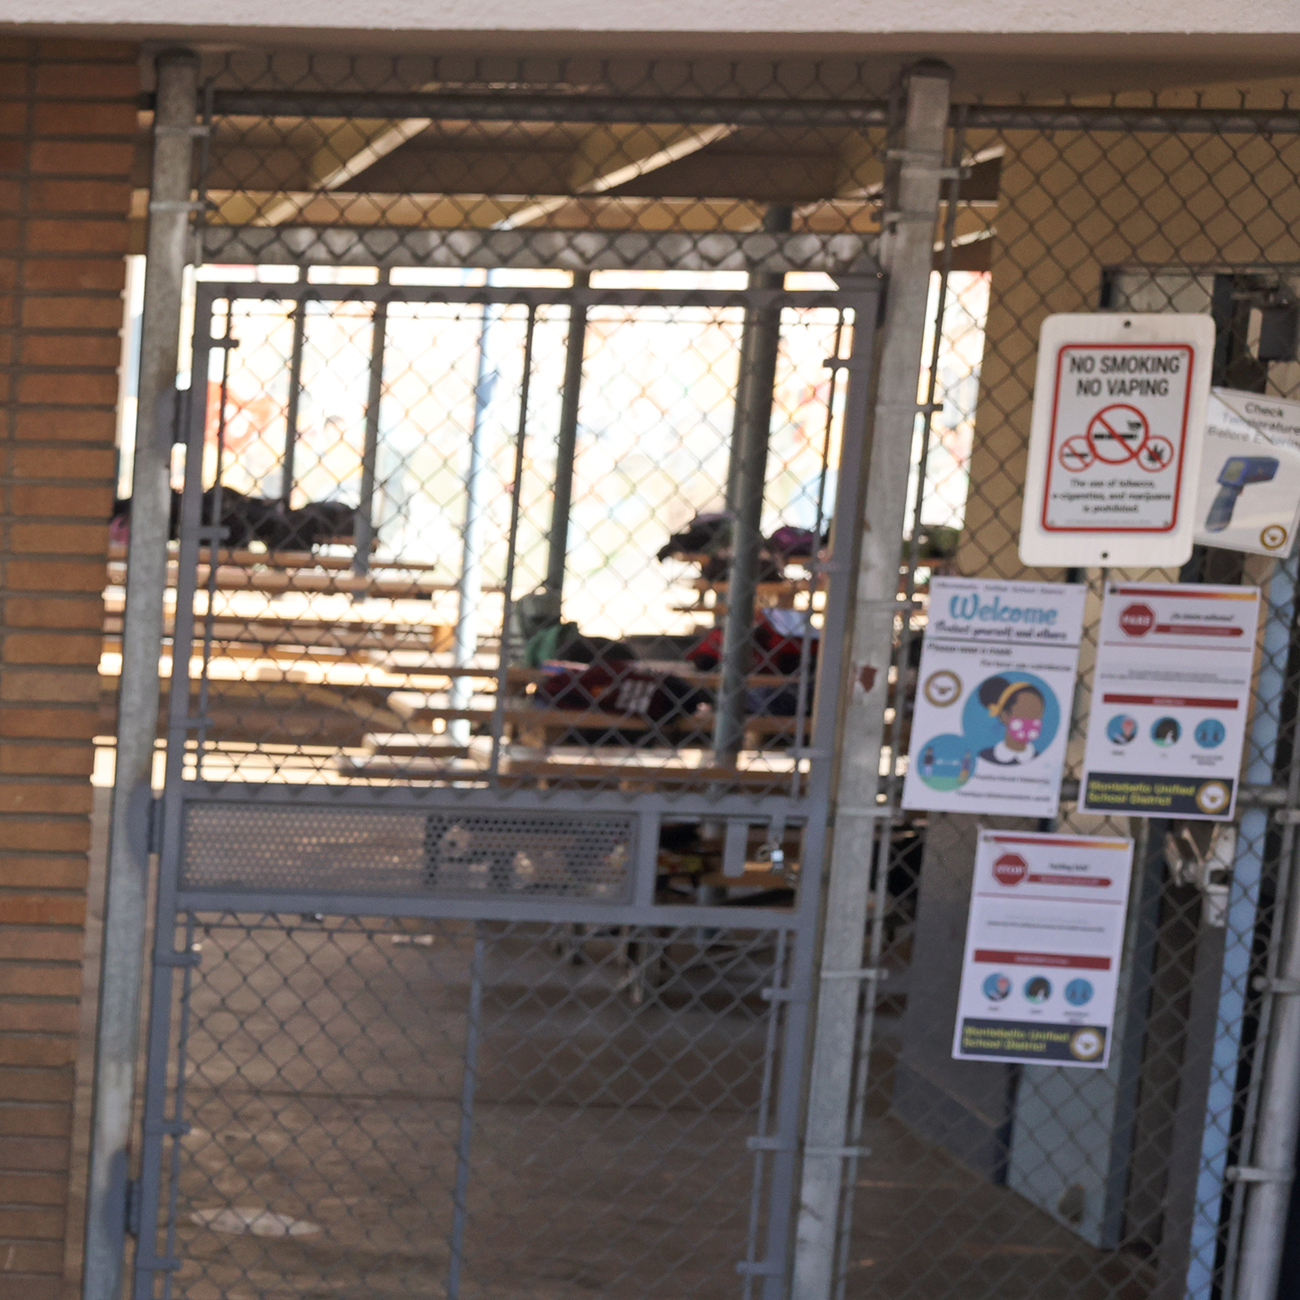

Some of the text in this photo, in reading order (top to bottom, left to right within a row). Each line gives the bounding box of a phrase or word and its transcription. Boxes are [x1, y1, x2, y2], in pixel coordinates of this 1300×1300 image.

[1070, 355, 1180, 375] NO SMOKING
[1076, 378, 1169, 397] NO VAPING
[1245, 402, 1284, 418] Check
[949, 593, 1058, 626] Welcome
